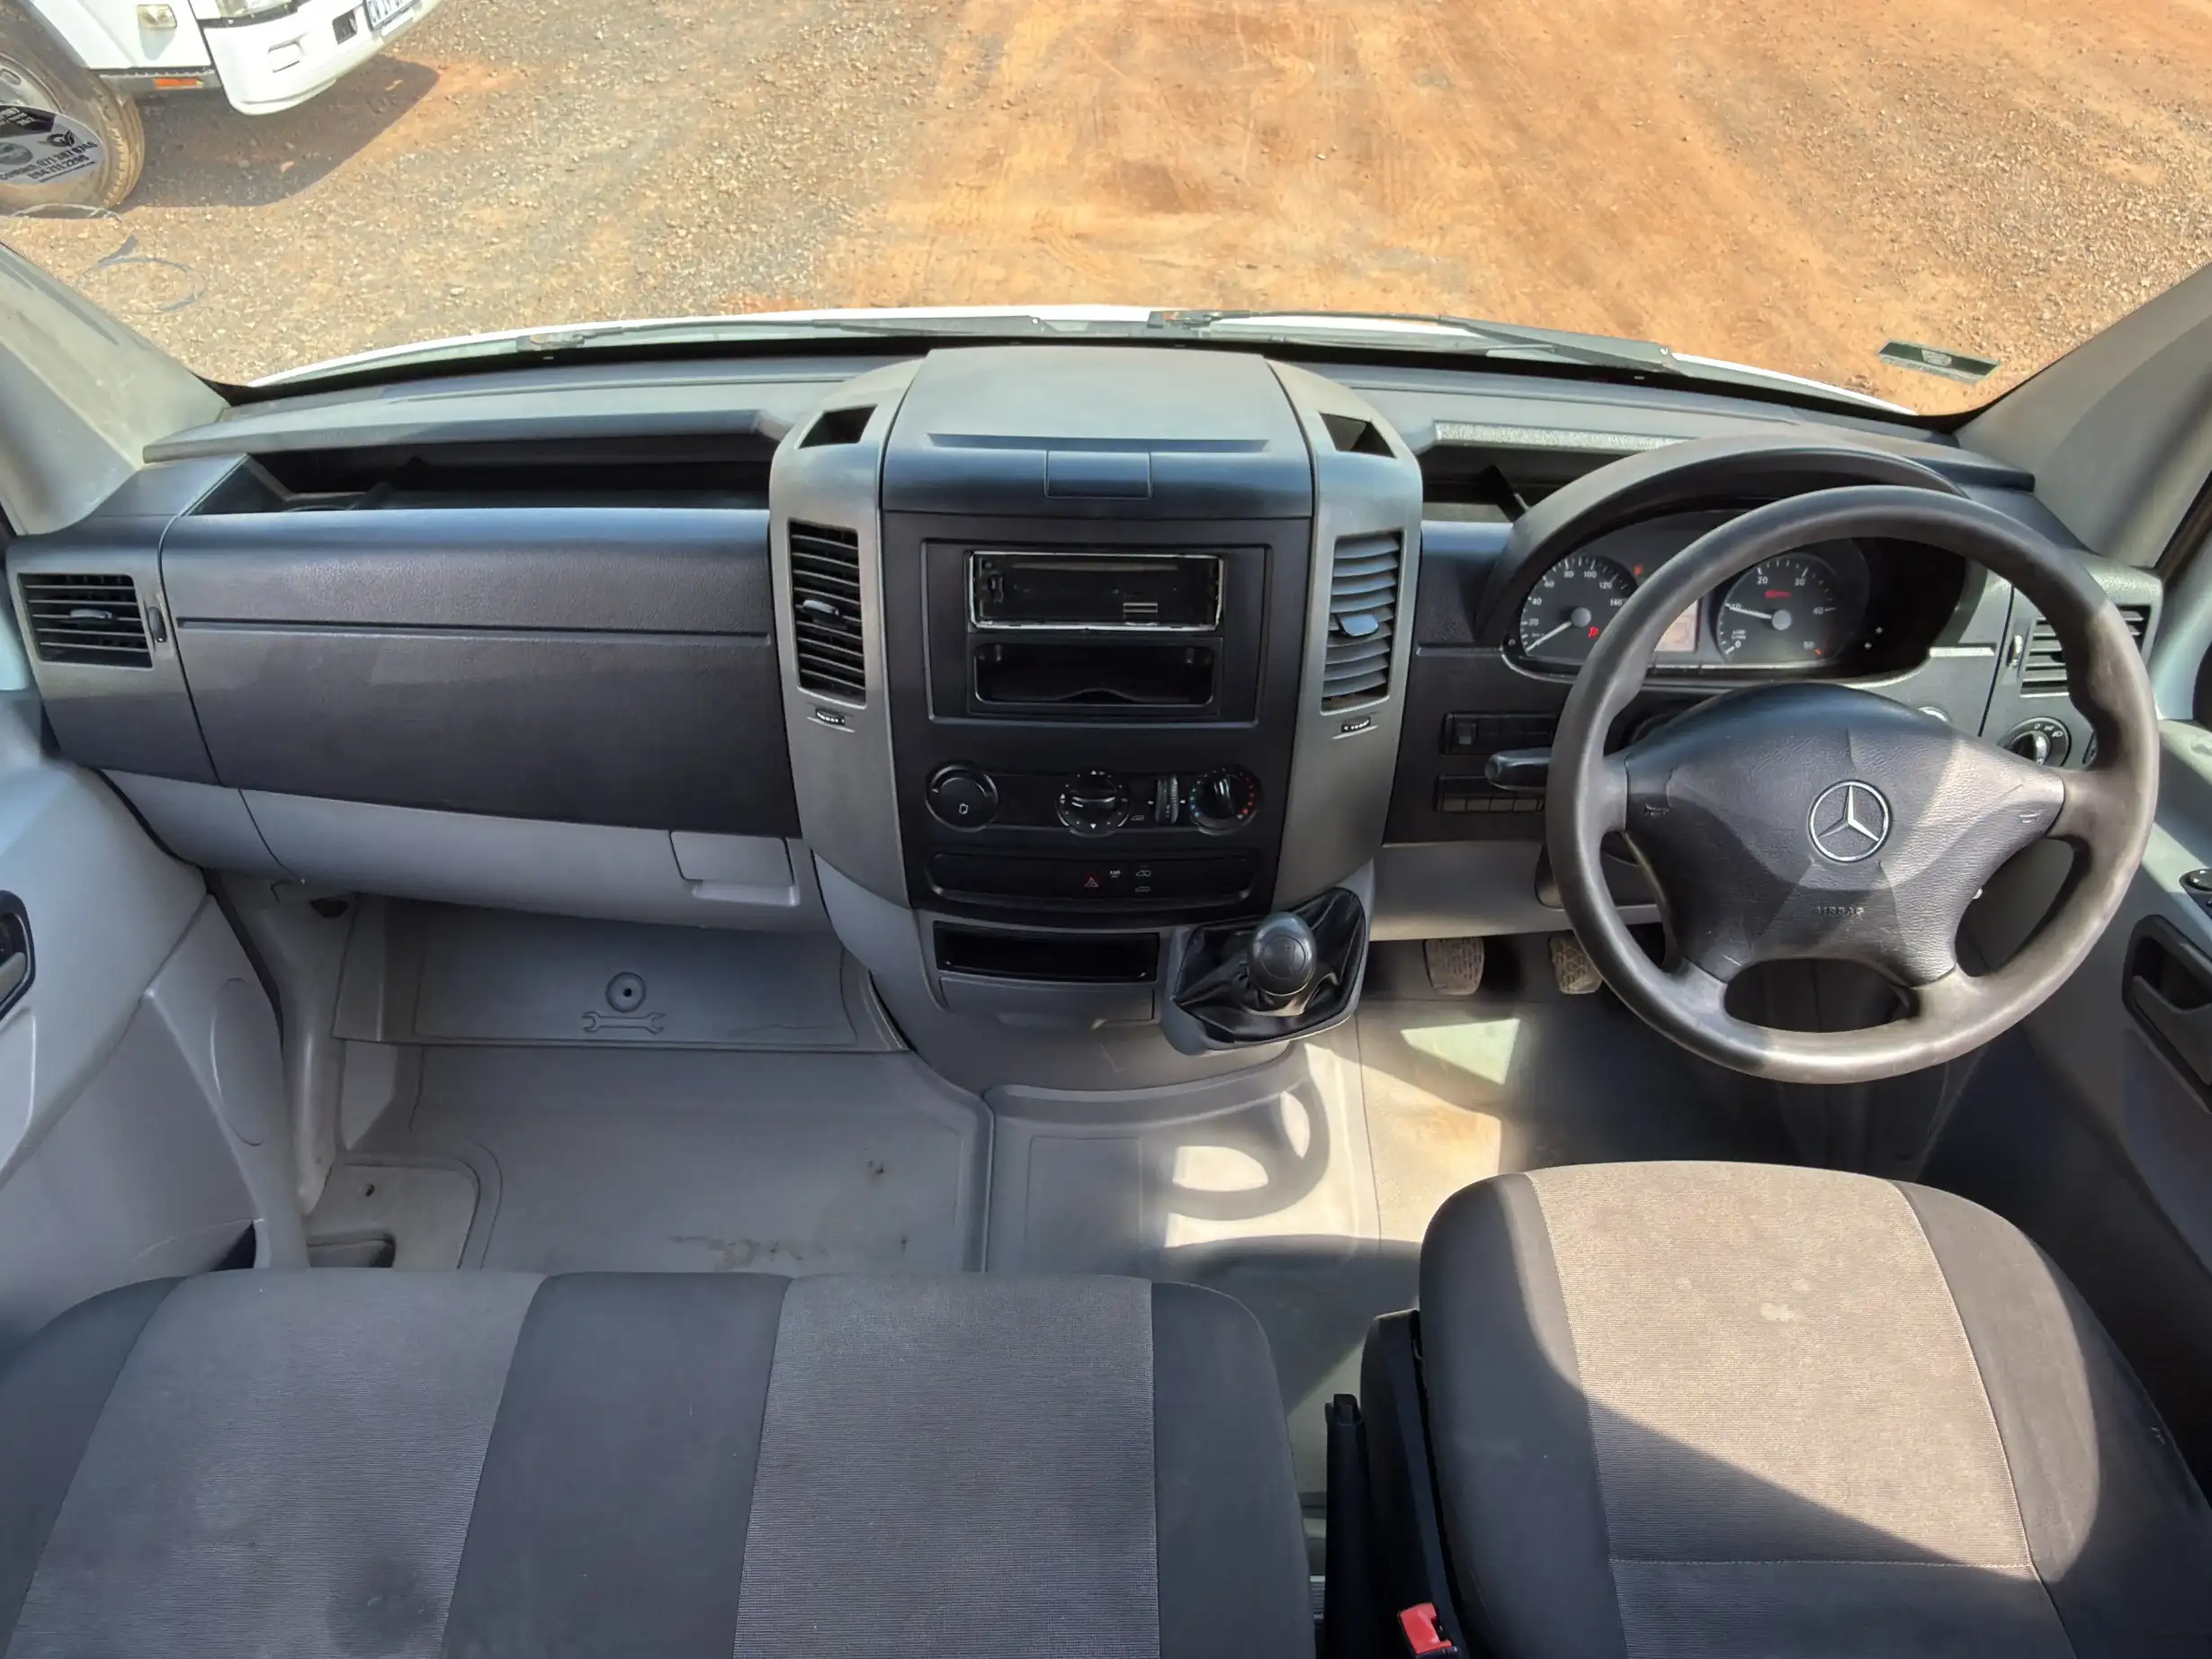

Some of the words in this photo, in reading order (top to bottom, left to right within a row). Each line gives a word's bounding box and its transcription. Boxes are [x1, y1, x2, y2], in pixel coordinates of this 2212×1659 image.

[1583, 570, 1598, 578] 100
[1599, 580, 1613, 589] 120
[1757, 576, 1769, 585] 20
[1531, 597, 1542, 605] 40
[1610, 598, 1623, 606] 140
[1813, 606, 1824, 615] 40
